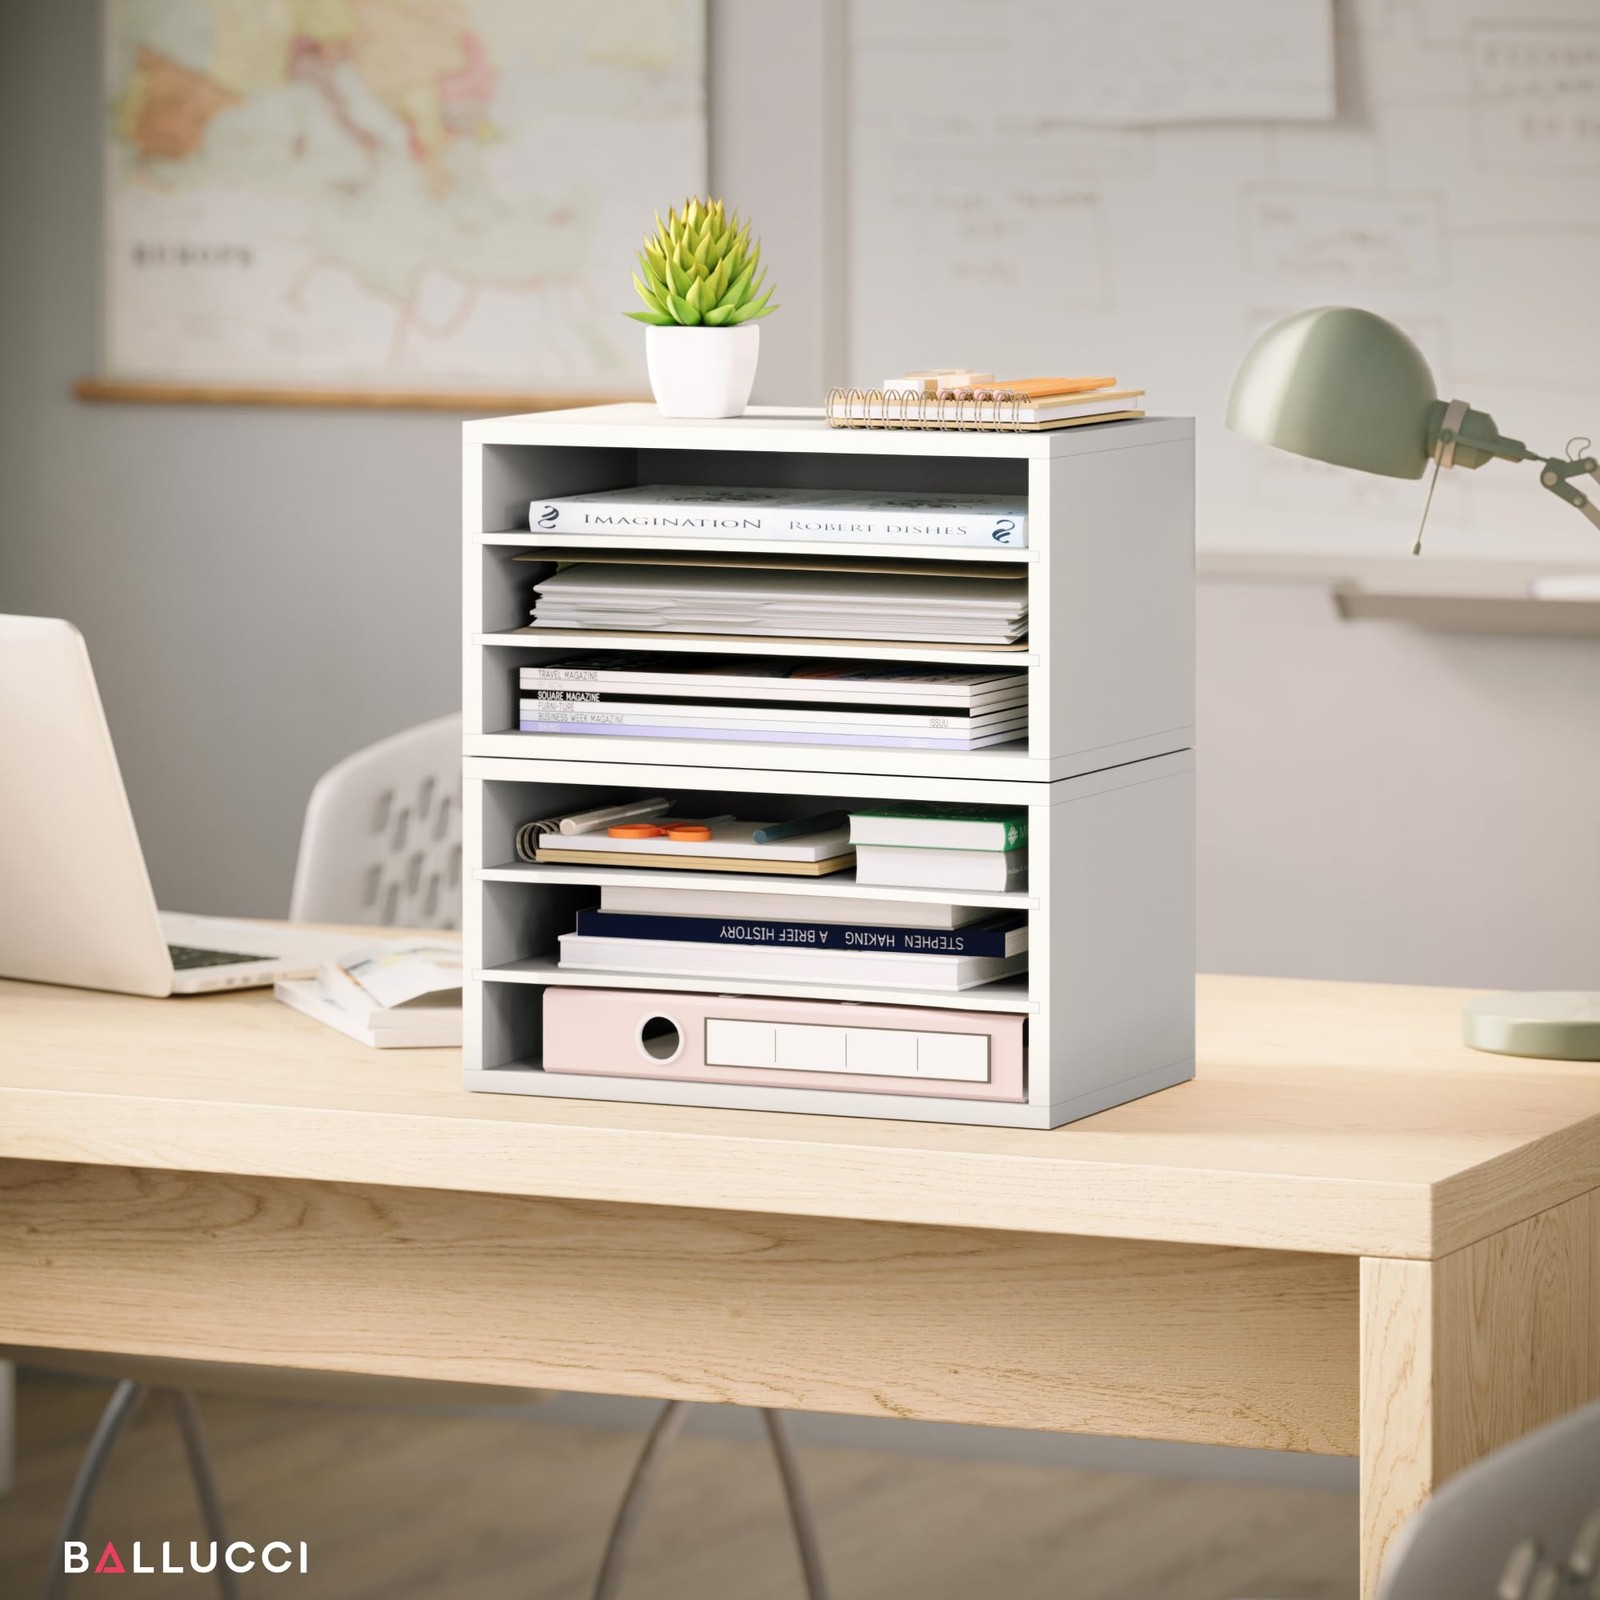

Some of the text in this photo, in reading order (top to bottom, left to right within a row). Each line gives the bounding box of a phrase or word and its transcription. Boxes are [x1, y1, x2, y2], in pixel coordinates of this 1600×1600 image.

[789, 520, 876, 533] ROBERT
[886, 525, 968, 536] DISHES
[538, 669, 598, 681] TRAVEL MAGAZINE
[537, 690, 600, 703] SQUARE MAGAZINE
[537, 712, 625, 725] BUSINESS WEEK MAGAZINE
[719, 925, 964, 951] STEPHEN HAKING A BRIEF HISTORY
